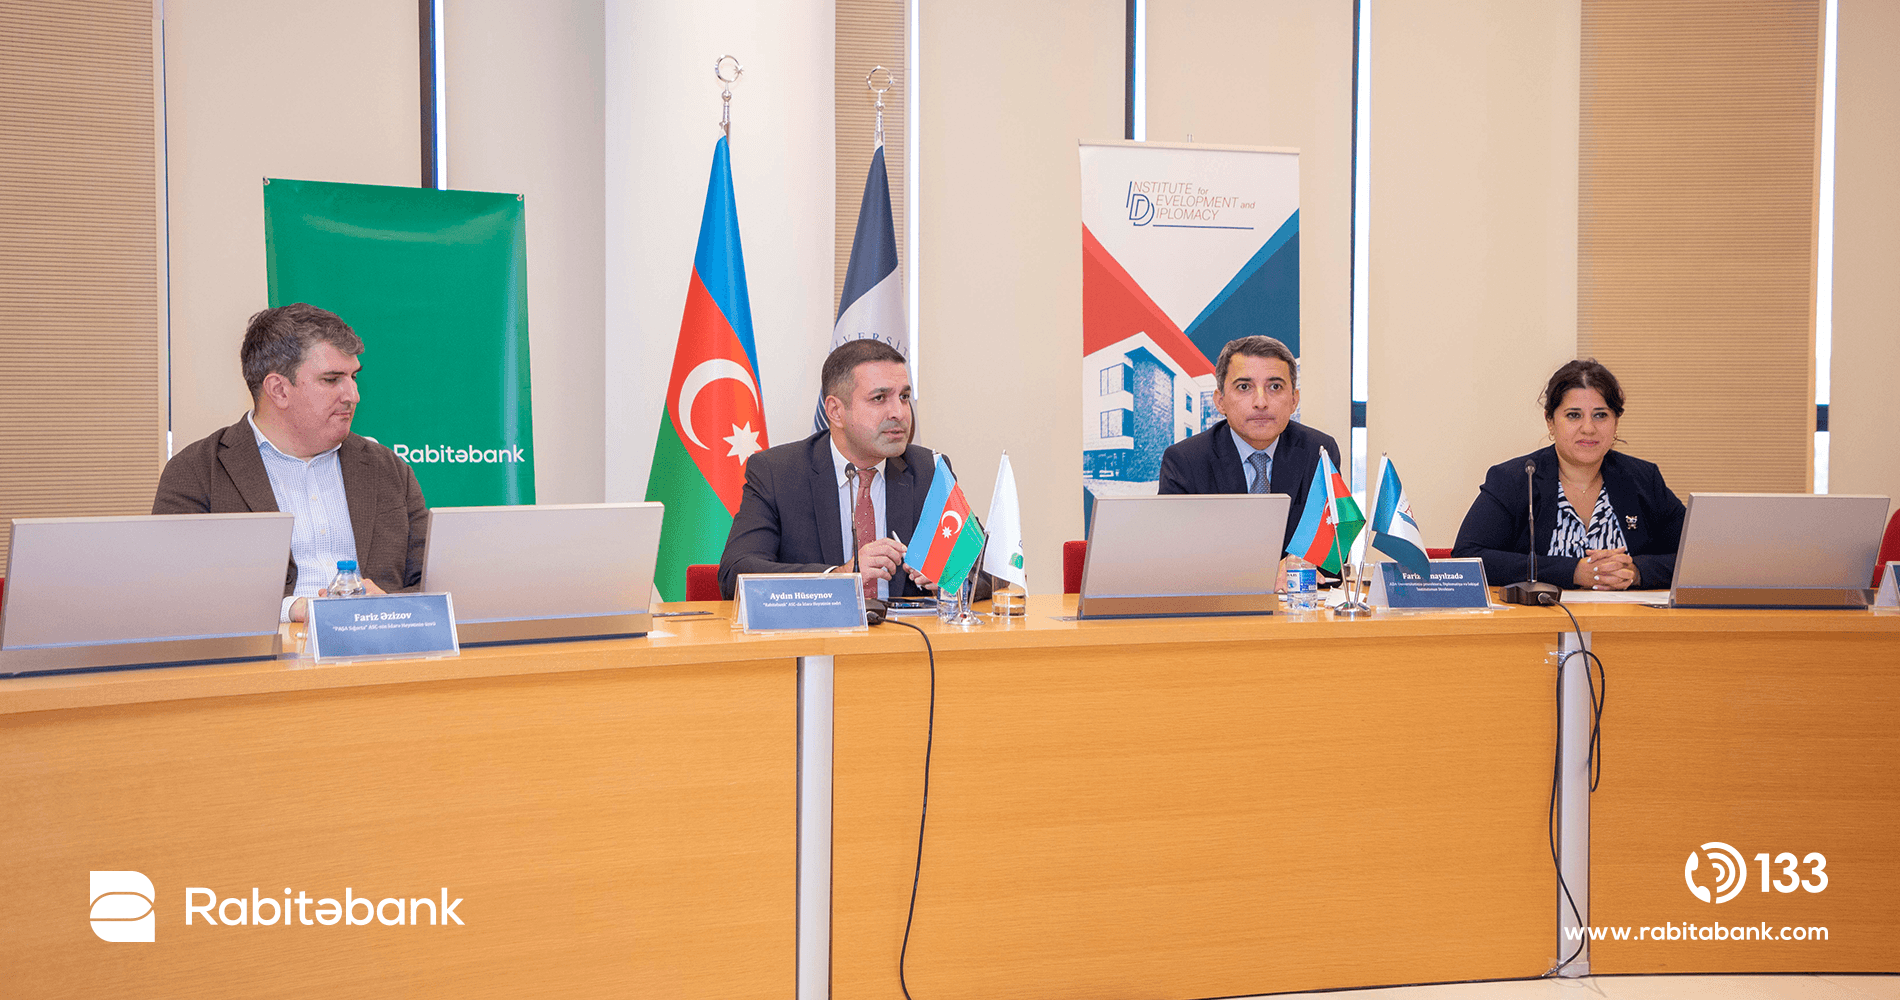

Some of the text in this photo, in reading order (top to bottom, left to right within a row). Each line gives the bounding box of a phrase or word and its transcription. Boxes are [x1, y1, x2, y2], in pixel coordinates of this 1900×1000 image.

[1197, 187, 1209, 195] for
[393, 444, 525, 463] Rabitəbank
[770, 591, 833, 601] Aydın Hüseynov
[354, 611, 412, 622] Fariz Əzizov
